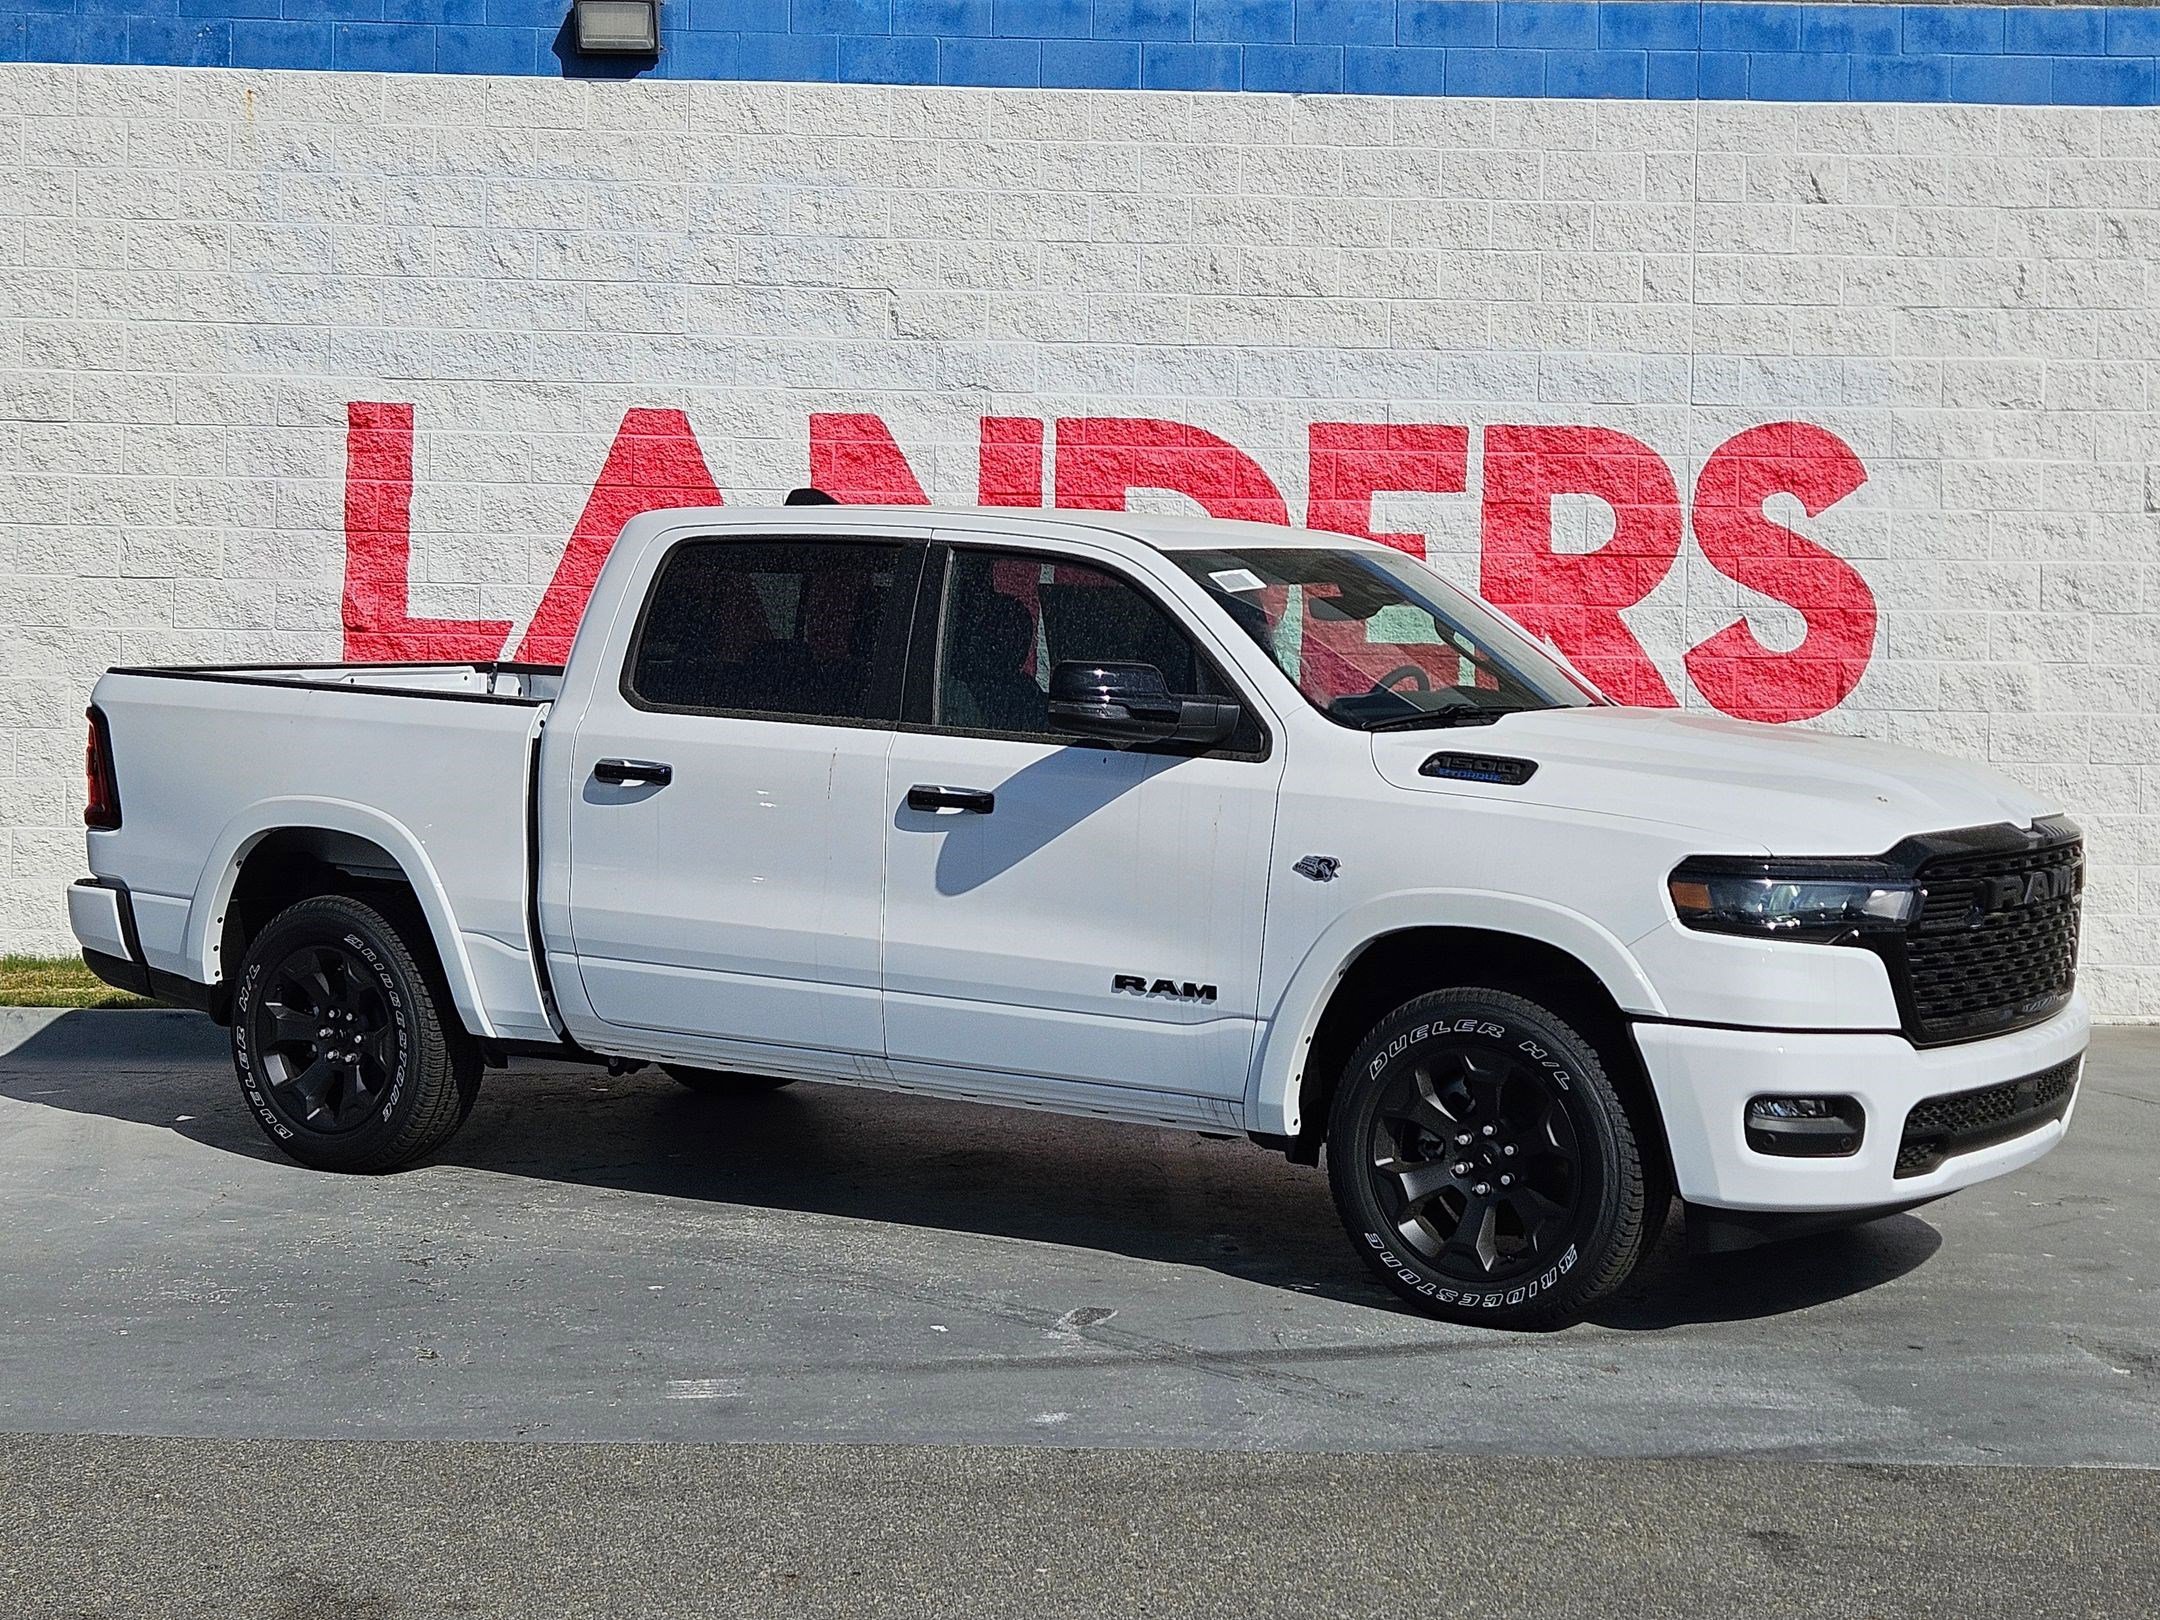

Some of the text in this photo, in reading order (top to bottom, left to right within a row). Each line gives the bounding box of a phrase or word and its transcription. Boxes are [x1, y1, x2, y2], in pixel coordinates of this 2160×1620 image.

[1439, 755, 1521, 775] 1500
[1988, 865, 2072, 910] RAM
[1113, 973, 1218, 1002] RAM
[344, 933, 408, 1122] BRIDGESTONE
[1368, 1018, 1505, 1081] DUELER
[236, 1025, 294, 1140] DUELER
[1364, 1231, 1579, 1308] BRIDGESTONE
